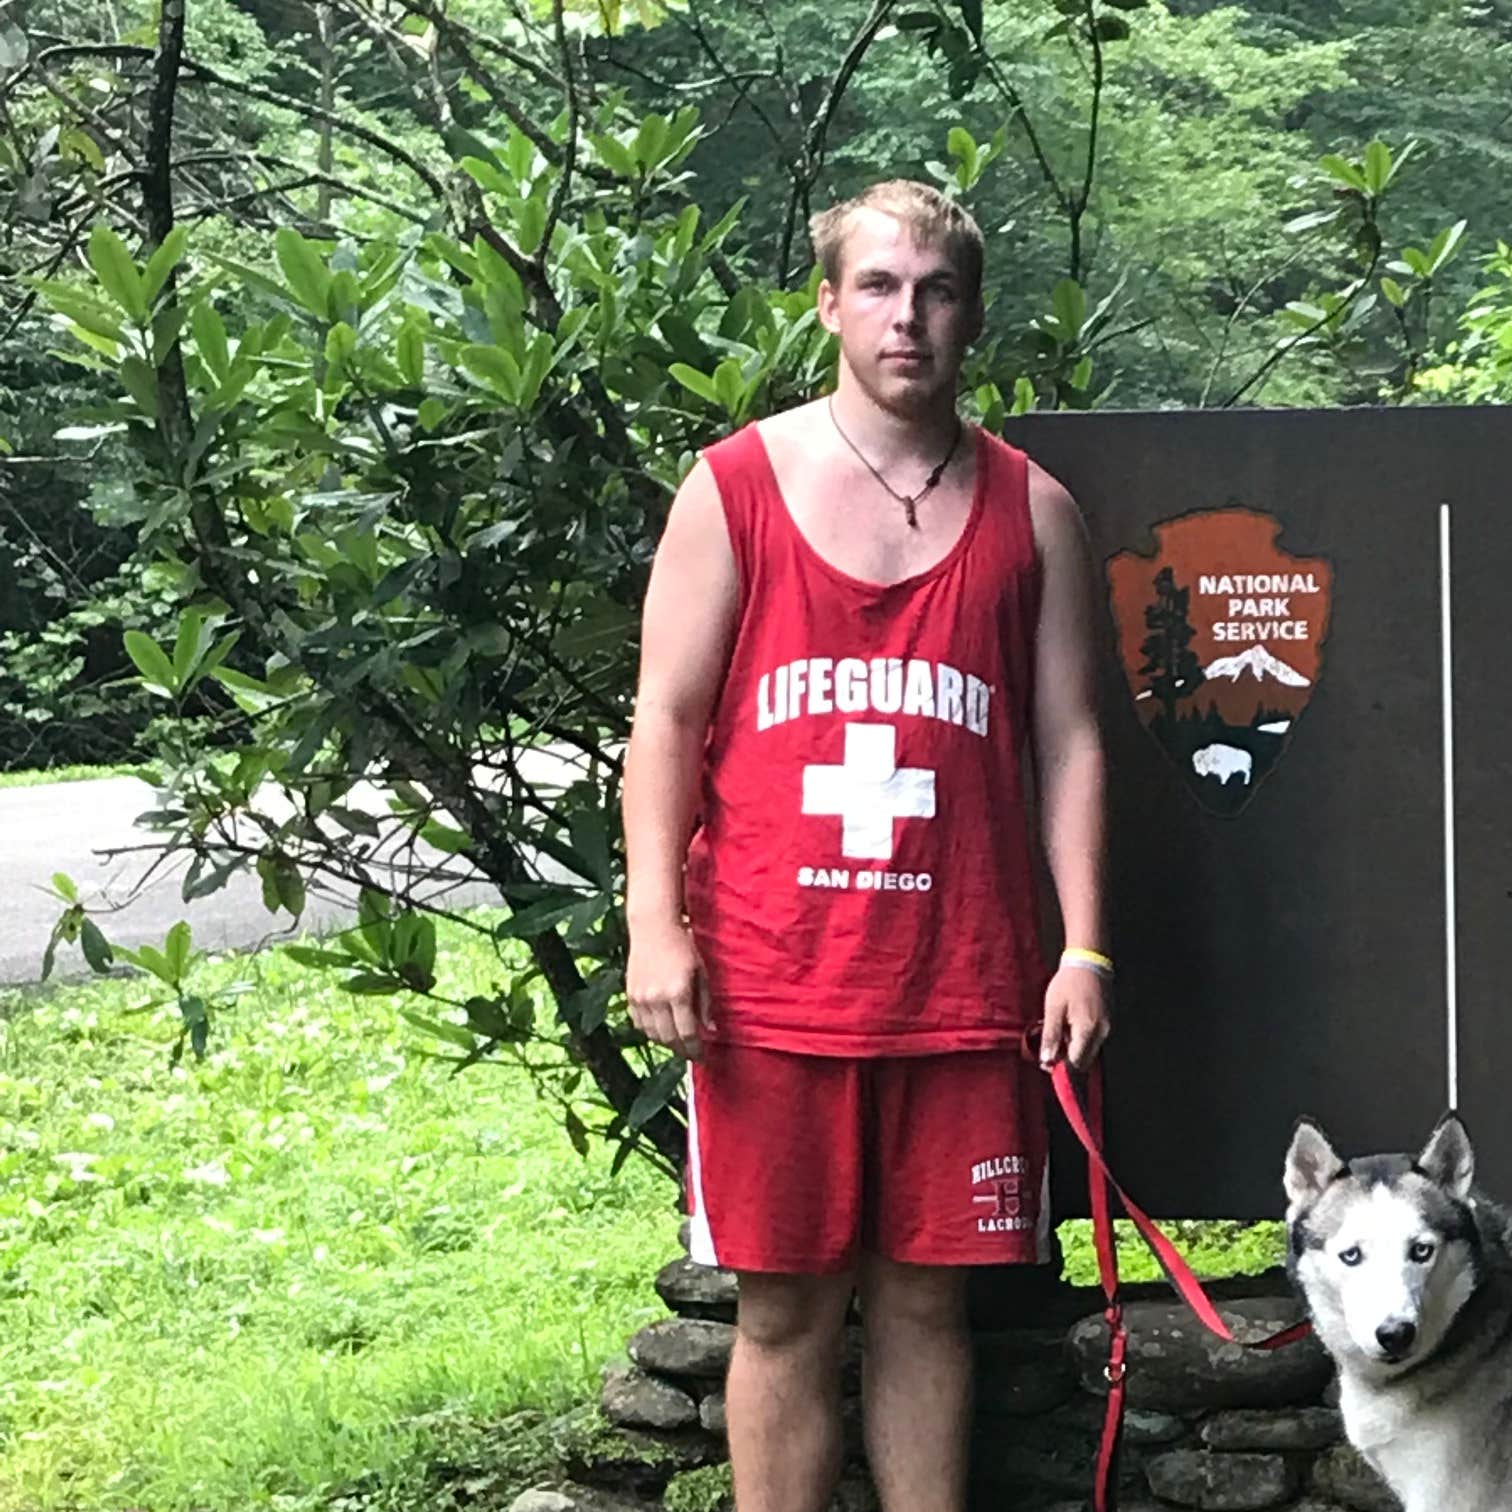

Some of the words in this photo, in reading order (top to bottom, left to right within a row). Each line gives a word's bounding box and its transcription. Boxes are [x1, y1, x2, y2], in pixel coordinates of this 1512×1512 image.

[1199, 573, 1320, 596] NATIONAL
[1228, 598, 1290, 617] PARK
[1212, 620, 1309, 641] SERVICE
[756, 656, 991, 738] LIFEGUARD
[796, 866, 850, 889] SAN
[855, 870, 933, 892] DIEGO
